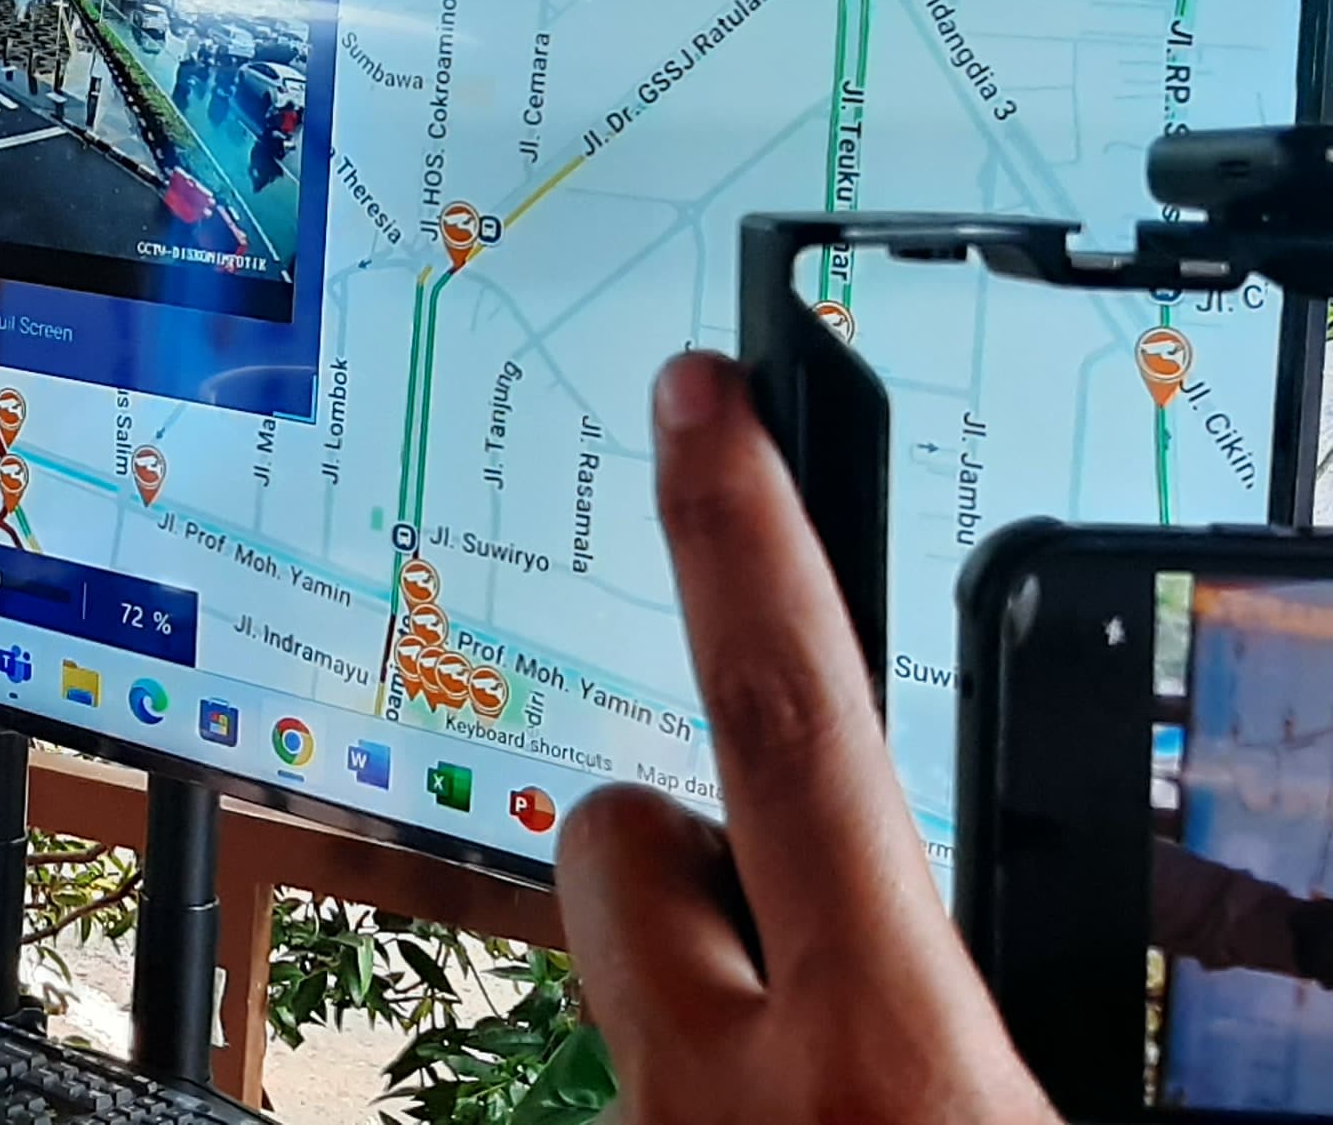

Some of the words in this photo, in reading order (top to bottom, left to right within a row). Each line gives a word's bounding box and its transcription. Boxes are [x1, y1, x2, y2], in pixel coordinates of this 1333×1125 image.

[342, 31, 424, 91] Sumbawa
[1169, 19, 1193, 55] Jl.
[524, 32, 551, 127] Cemara
[842, 80, 865, 111] Jl.
[580, 127, 611, 157] Jl.
[609, 102, 640, 135] Dr.
[994, 100, 1017, 123] 3
[424, 149, 444, 206] HOS.
[519, 135, 540, 165] Jl.
[836, 121, 862, 203] Teuku
[337, 156, 401, 244] Theresia
[20, 316, 74, 342] Screen
[329, 359, 349, 451] Lombok
[487, 360, 523, 454] Tanjung
[580, 415, 602, 443] Jl.
[962, 411, 988, 444] Jl.
[116, 416, 132, 475] Salim
[322, 454, 339, 484] Jl.
[484, 462, 505, 490] Jl.
[955, 452, 983, 545] Jambu
[572, 452, 600, 574] Rasamala
[157, 511, 178, 535] Jl.
[235, 543, 281, 580] Moh.
[290, 570, 352, 607] Yamin
[429, 527, 456, 549] Jl.
[462, 533, 551, 574] Suwiryo
[120, 603, 144, 629] 72
[153, 612, 172, 636] %
[233, 615, 256, 640] Jl.
[263, 621, 370, 686] Indramayu
[458, 630, 506, 664] Prof.
[515, 657, 569, 694] Moh.
[579, 679, 653, 727] Yamin
[445, 713, 526, 751] Keyboard
[530, 735, 613, 773] shortcuts
[636, 761, 681, 793] Map
